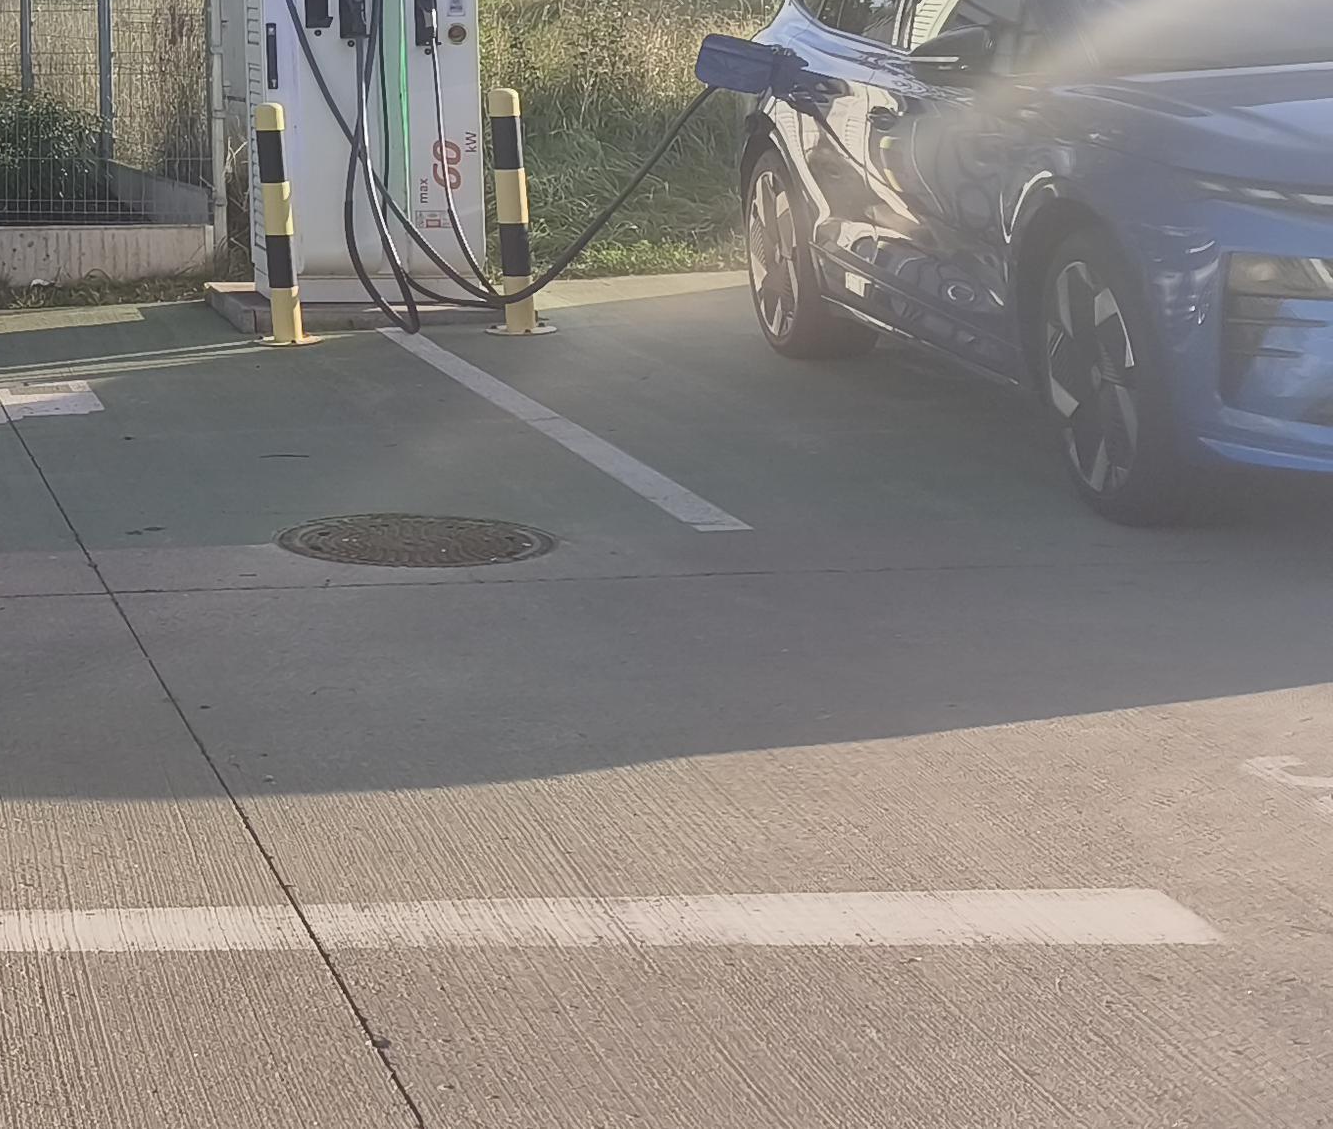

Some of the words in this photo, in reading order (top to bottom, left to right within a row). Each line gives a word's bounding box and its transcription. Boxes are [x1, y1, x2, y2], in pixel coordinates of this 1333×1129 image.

[419, 177, 429, 204] max
[432, 139, 462, 190] 60
[465, 131, 477, 153] kW
